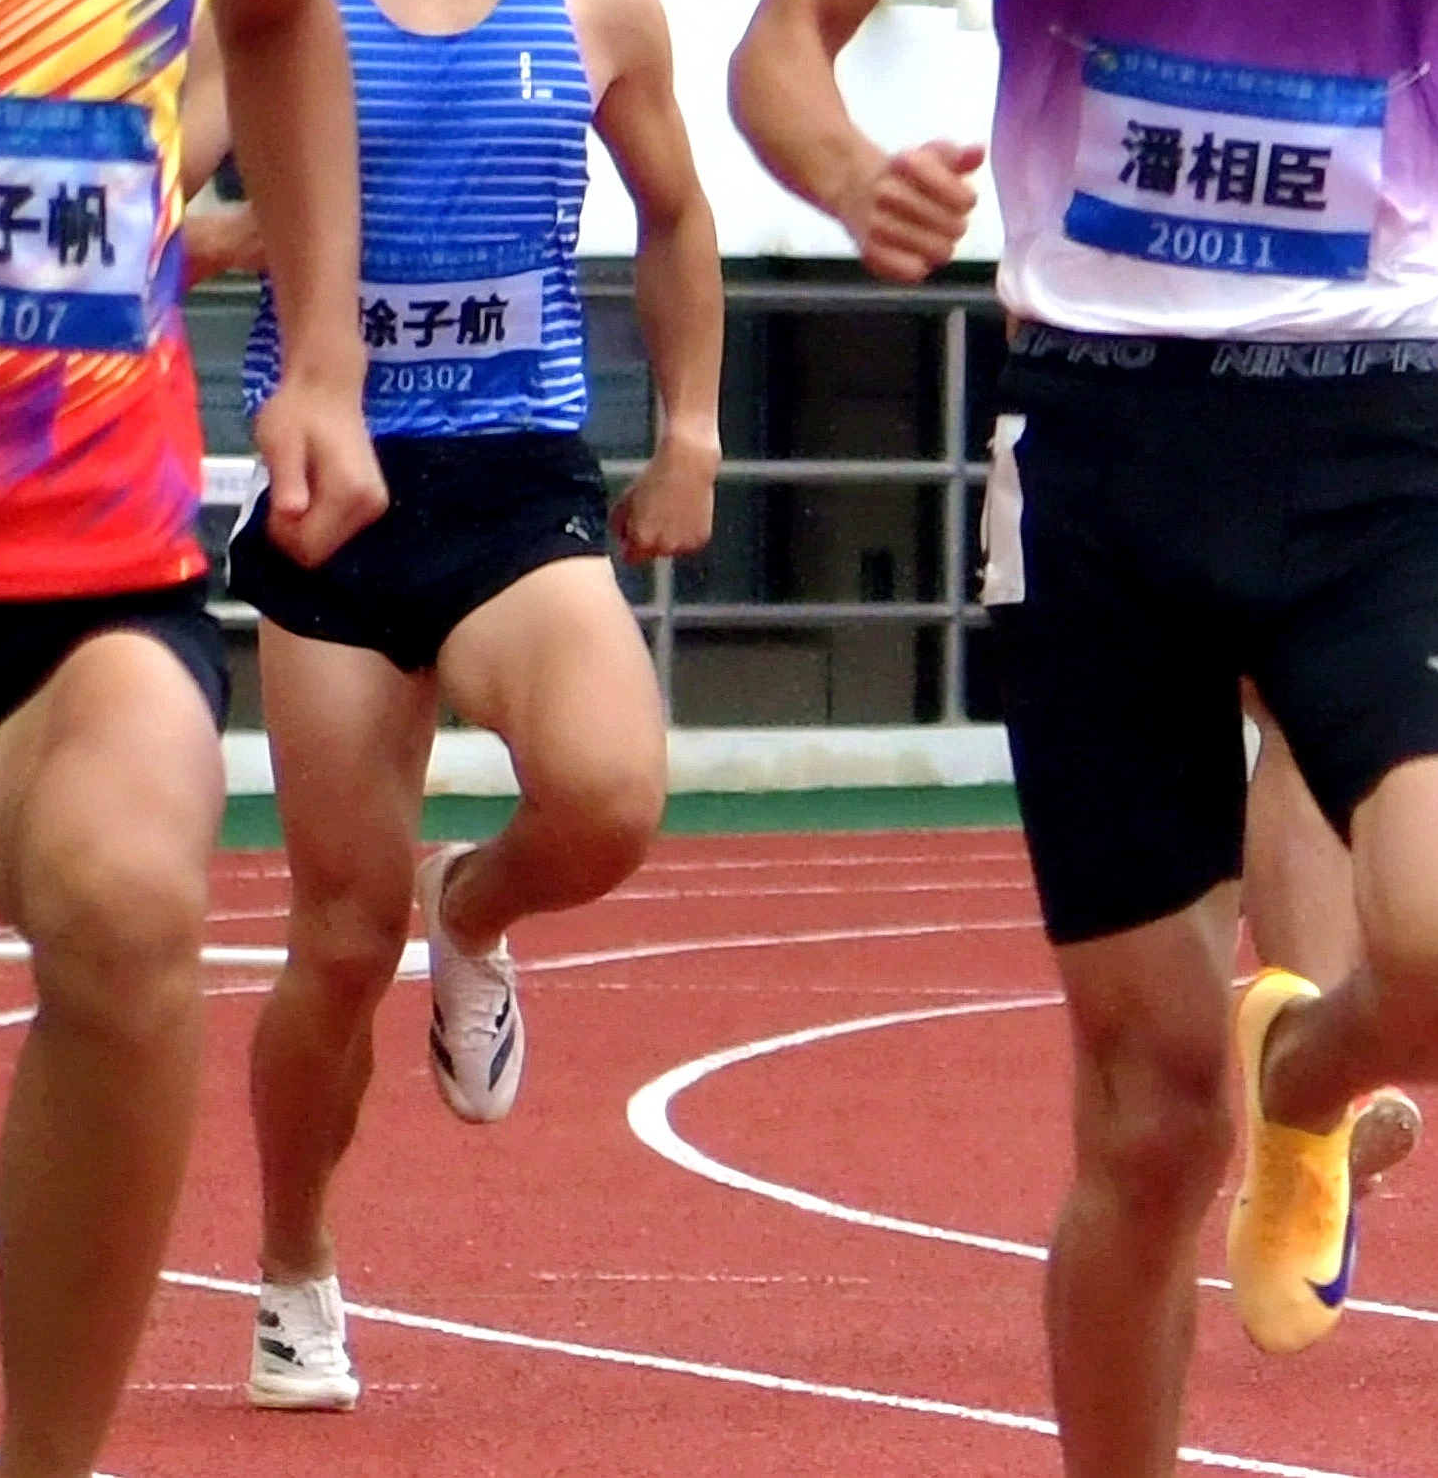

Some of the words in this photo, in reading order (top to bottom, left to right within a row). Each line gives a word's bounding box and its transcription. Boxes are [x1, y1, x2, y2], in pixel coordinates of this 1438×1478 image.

[1118, 119, 1332, 212] 潘相臣
[1147, 222, 1276, 269] 20011
[378, 364, 475, 393] 20302
